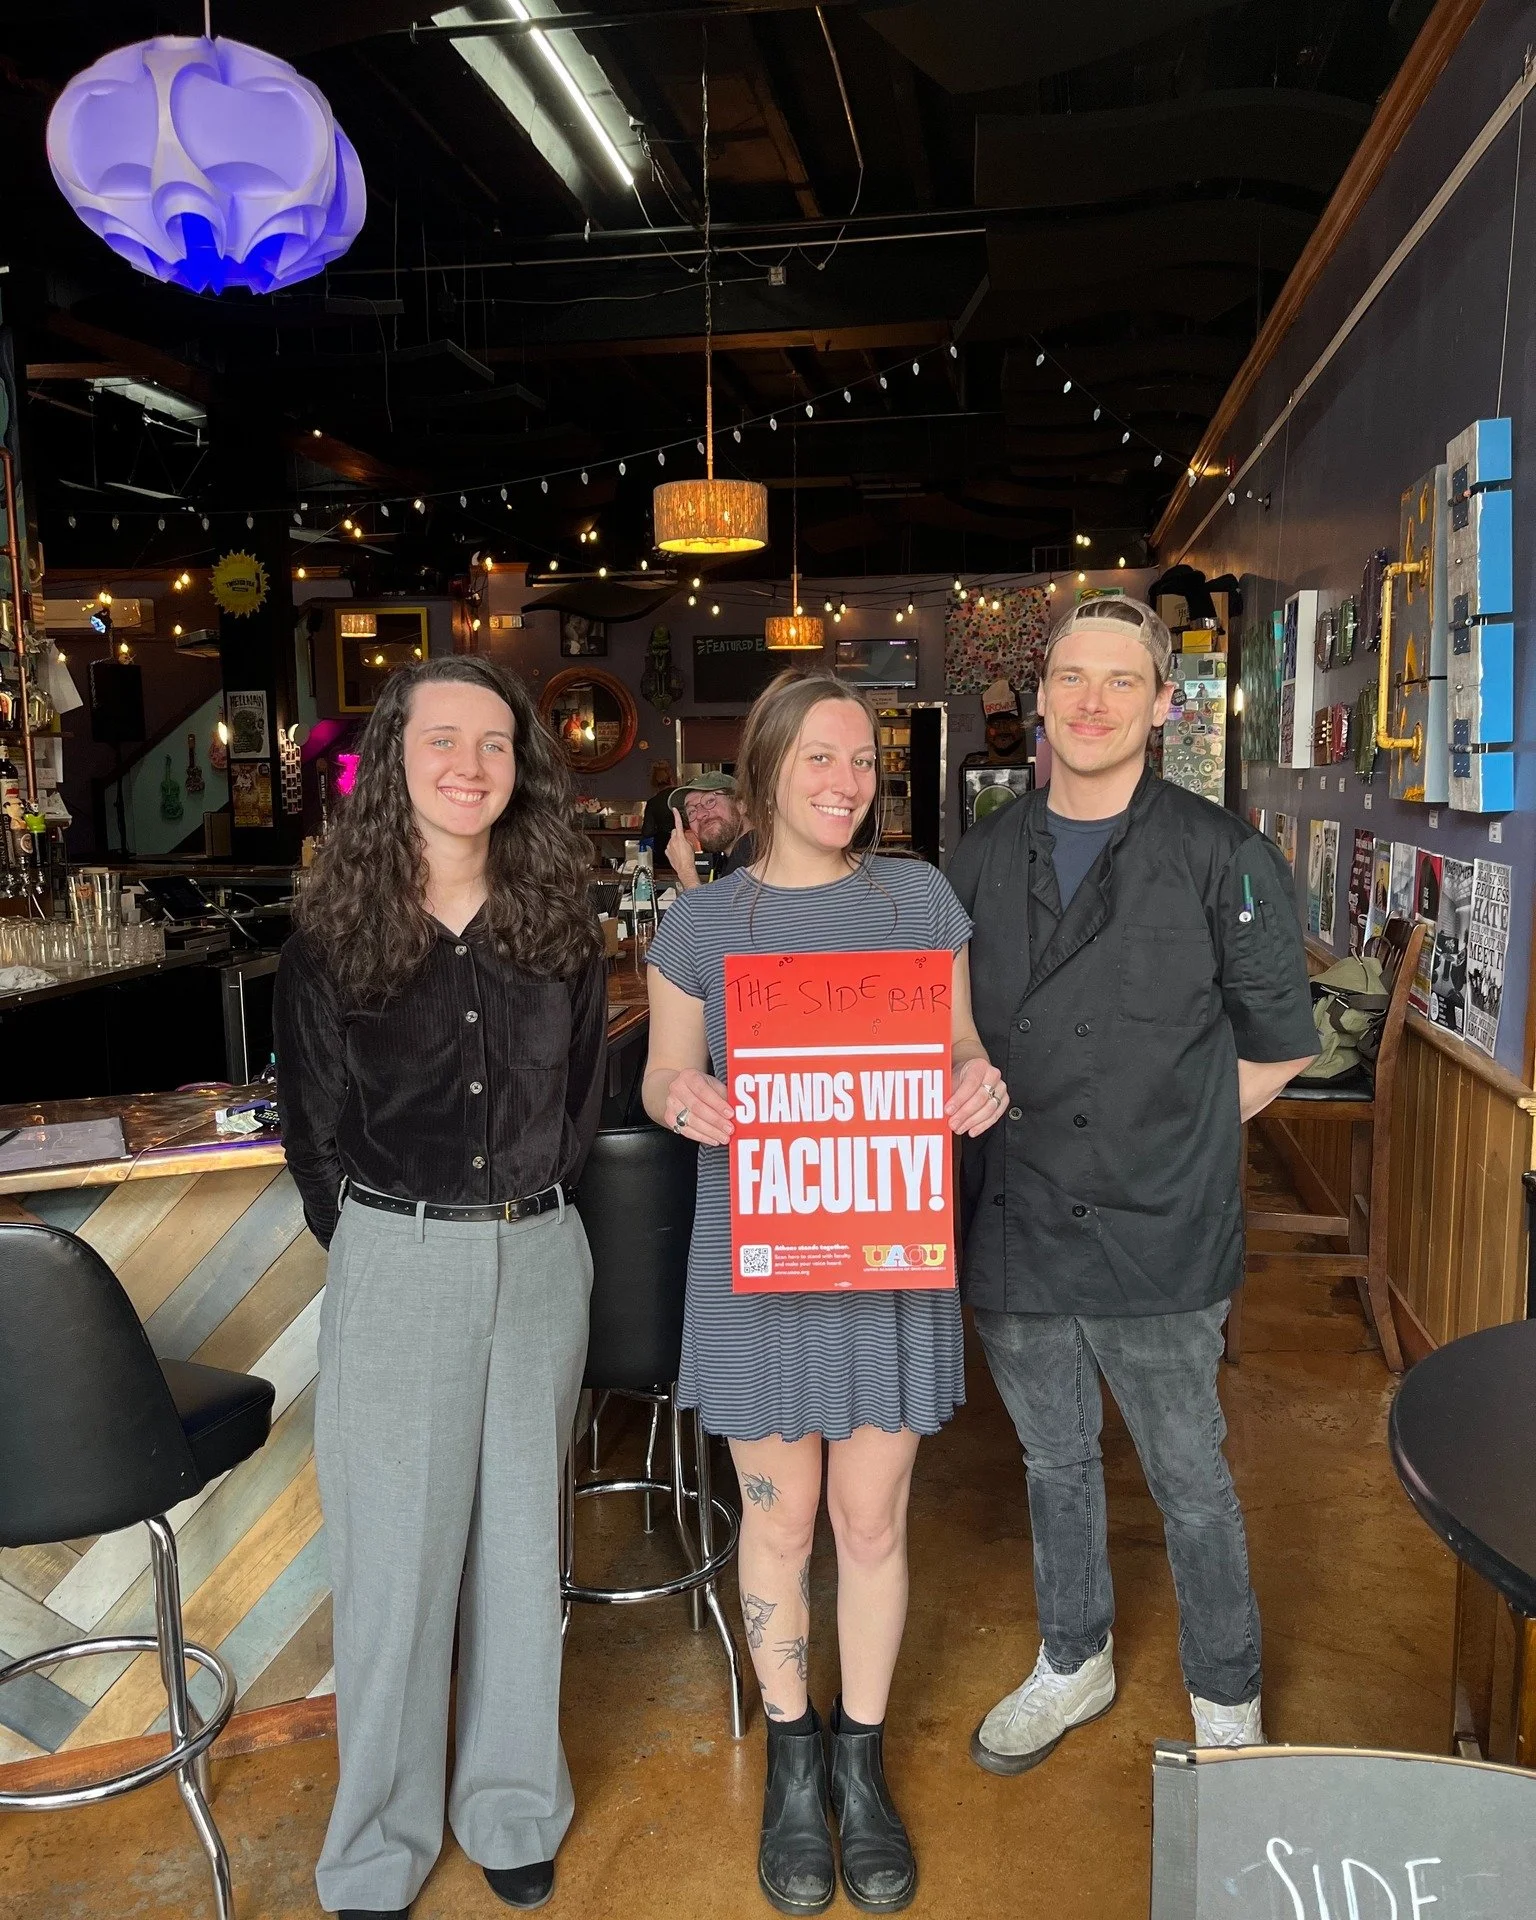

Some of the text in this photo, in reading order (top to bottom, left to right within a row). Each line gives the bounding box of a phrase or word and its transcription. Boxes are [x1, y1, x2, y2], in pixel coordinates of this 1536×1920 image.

[705, 639, 754, 654] FEATURED
[1472, 897, 1509, 933] HATE
[1469, 941, 1495, 967] MEET
[726, 974, 951, 1014] THE SIDE BAR
[734, 1069, 944, 1124] STANDS WITH
[737, 1134, 945, 1215] FACULTY!
[862, 1243, 947, 1267] UAOU
[1266, 1837, 1442, 1920] SIDE
